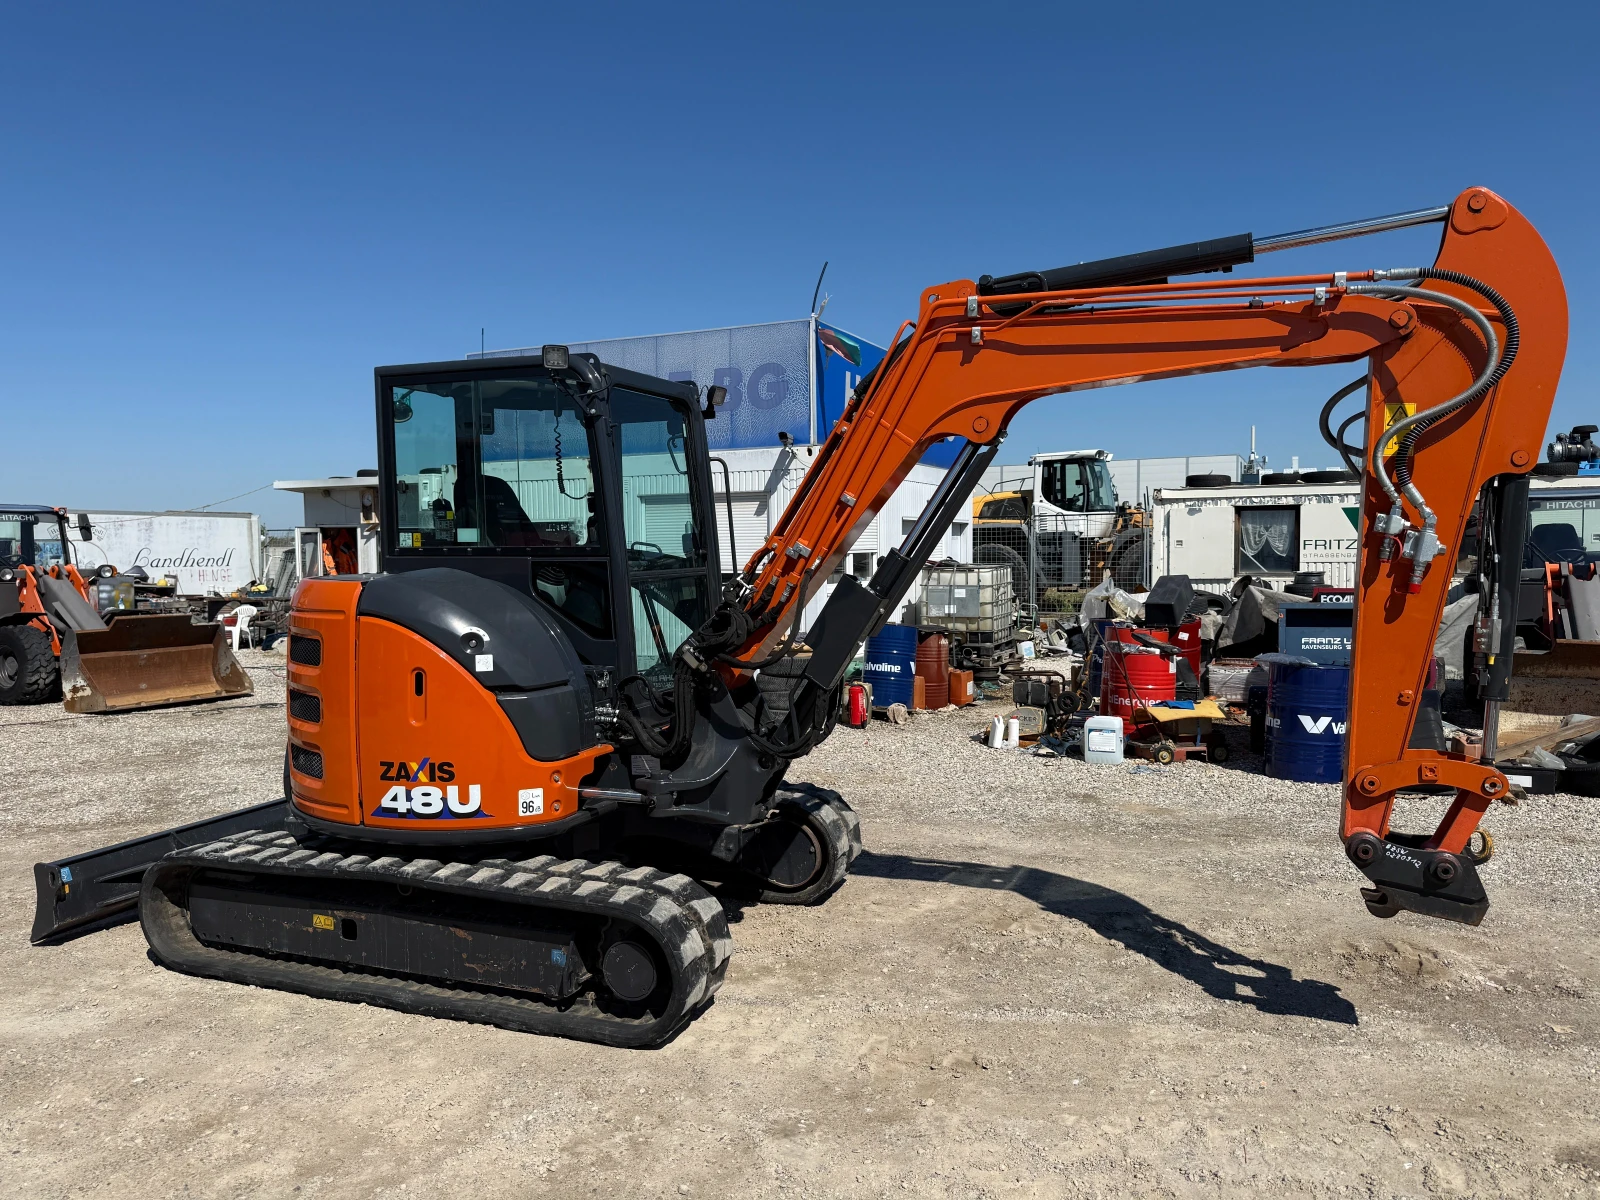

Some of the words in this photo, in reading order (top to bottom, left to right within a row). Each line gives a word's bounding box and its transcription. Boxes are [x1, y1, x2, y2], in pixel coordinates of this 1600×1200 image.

[1546, 500, 1596, 509] HITACHI
[1303, 538, 1358, 550] FRITZ
[1301, 637, 1341, 645] FRANZ
[380, 757, 456, 783] ZAXIS
[381, 784, 482, 818] 48U
[521, 800, 535, 814] 96
